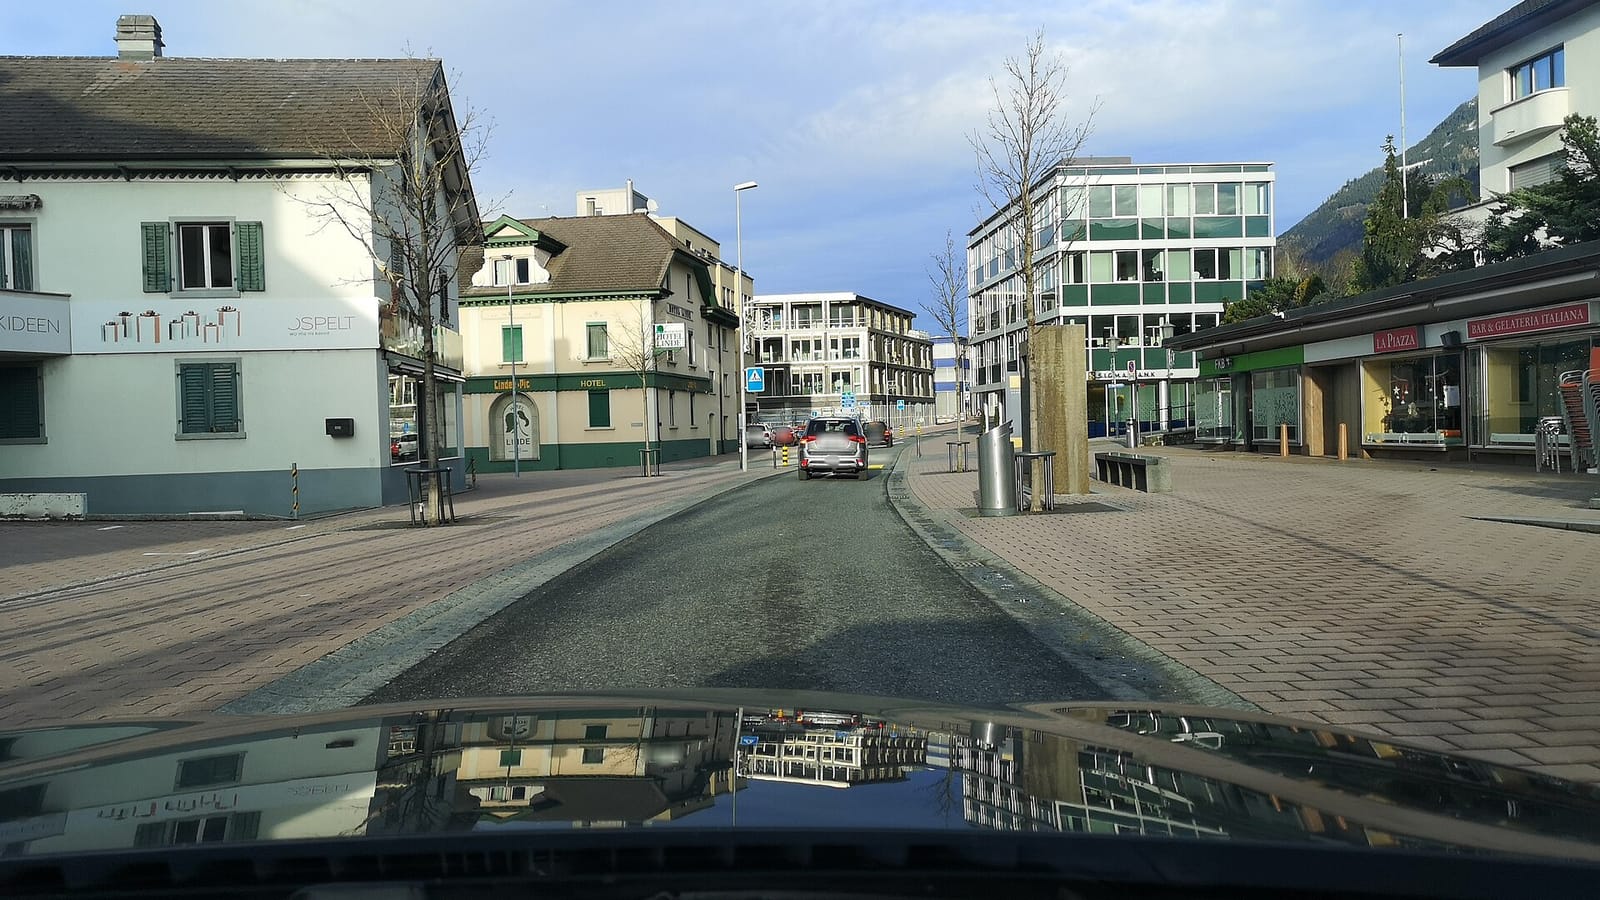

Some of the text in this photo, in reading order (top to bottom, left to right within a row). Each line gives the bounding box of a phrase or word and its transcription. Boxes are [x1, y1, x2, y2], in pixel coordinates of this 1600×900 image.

[1471, 309, 1584, 335] BAR & GELATERIA ITALIANA
[656, 333, 683, 341] HOTEL
[1376, 332, 1416, 349] LA PIAZZA
[1134, 370, 1156, 378] ANK
[580, 379, 607, 388] HOTEL
